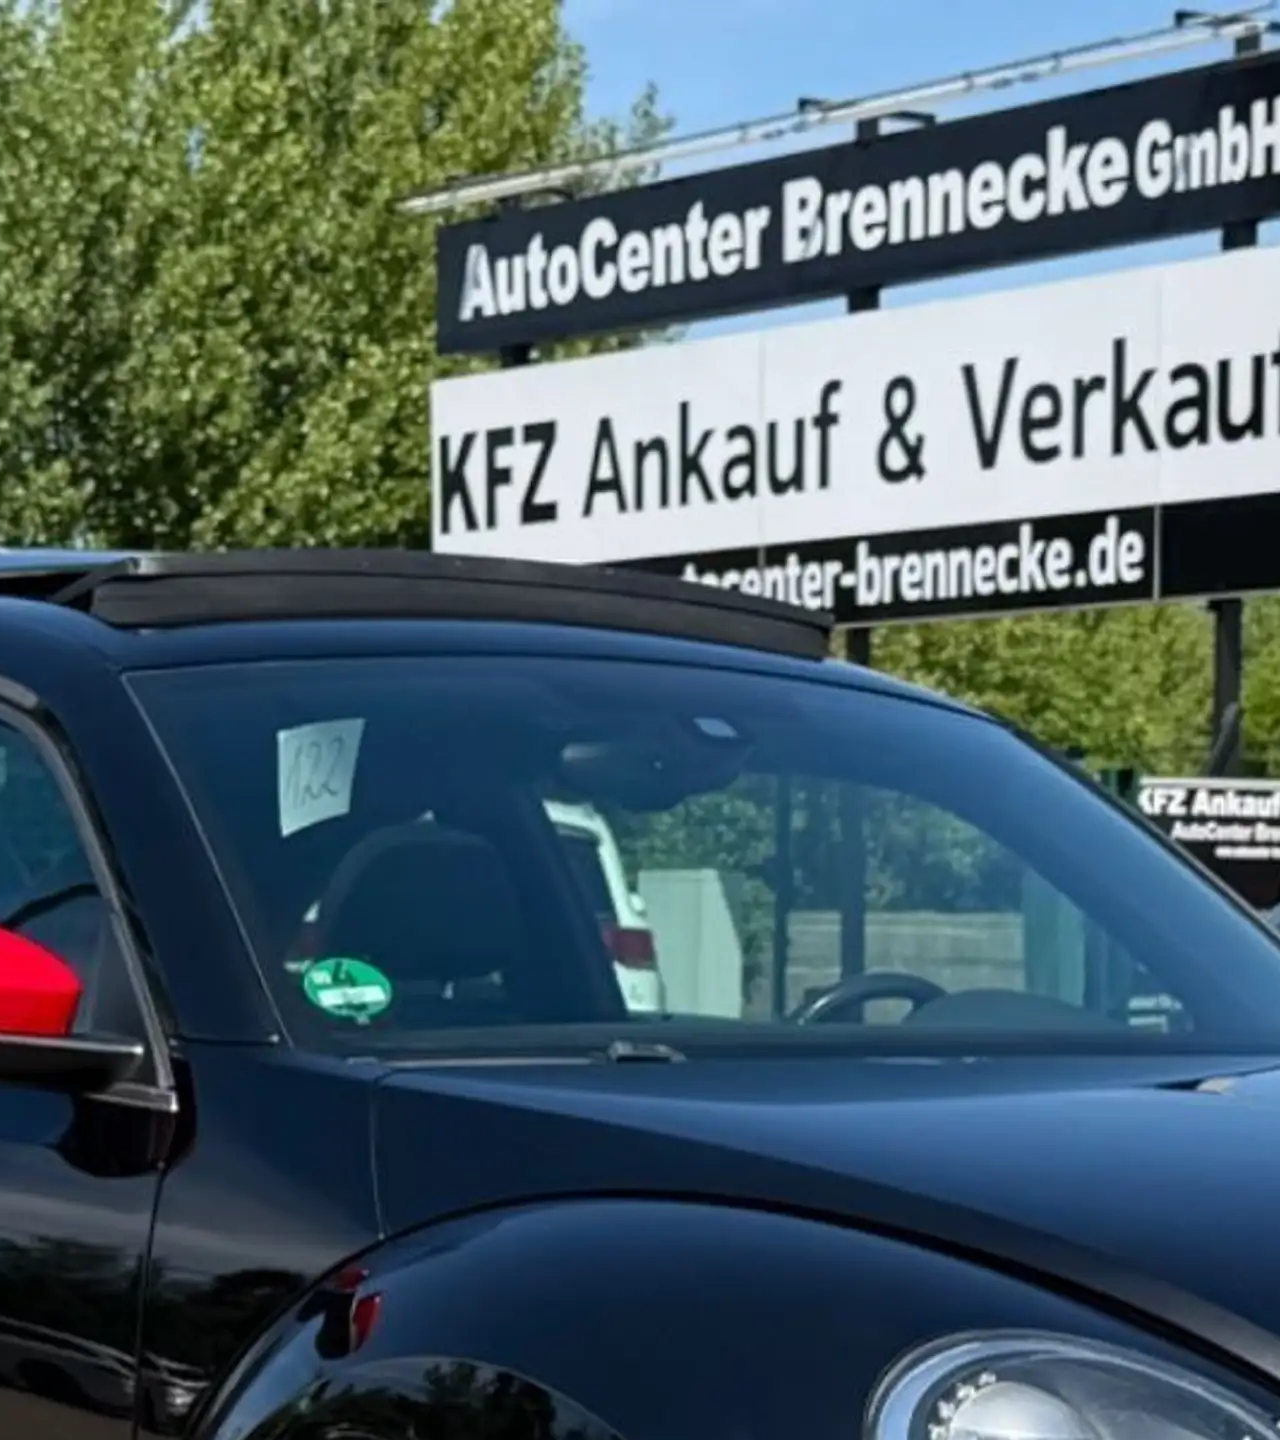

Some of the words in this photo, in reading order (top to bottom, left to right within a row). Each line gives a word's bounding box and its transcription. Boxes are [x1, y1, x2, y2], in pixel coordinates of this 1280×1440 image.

[458, 200, 772, 322] AutoCenter
[780, 126, 1129, 264] Brennecke
[438, 420, 559, 535] KFZ
[581, 379, 843, 518] Ankauf
[875, 374, 926, 485] &
[680, 514, 1146, 612] enter-brennecke.de
